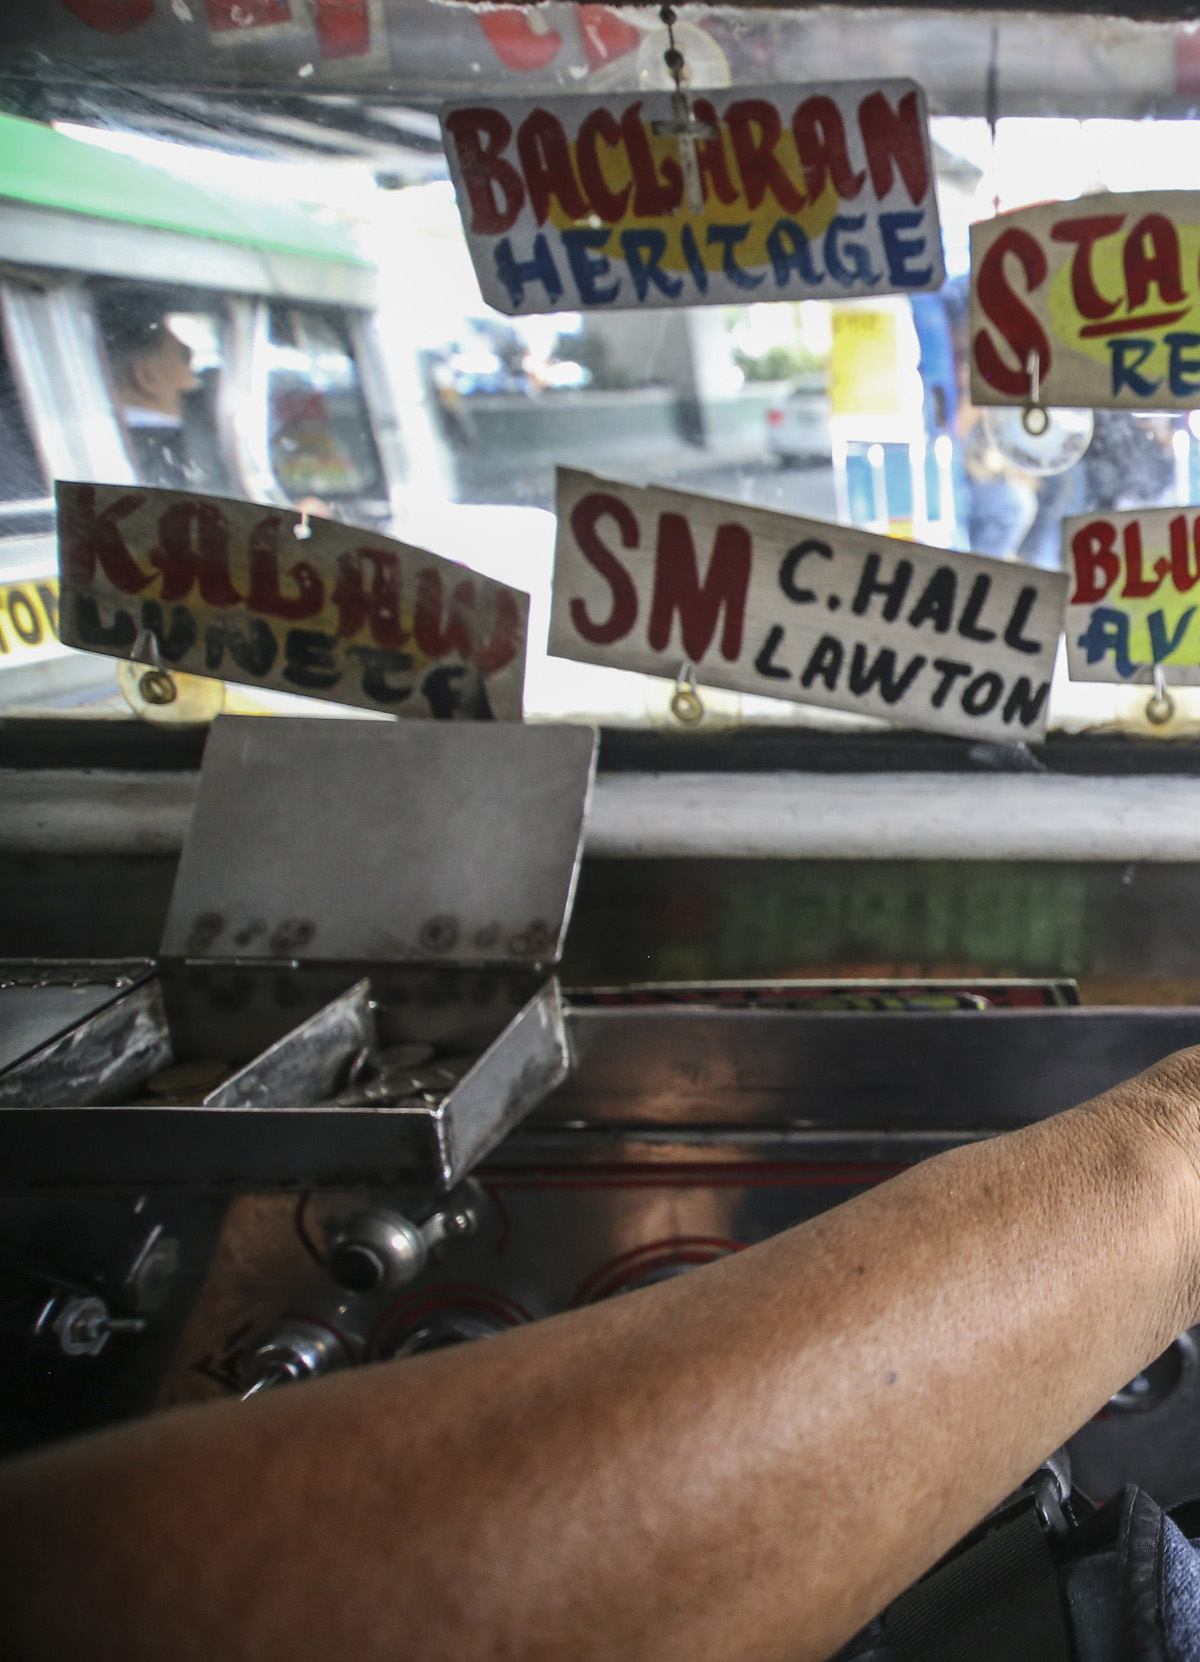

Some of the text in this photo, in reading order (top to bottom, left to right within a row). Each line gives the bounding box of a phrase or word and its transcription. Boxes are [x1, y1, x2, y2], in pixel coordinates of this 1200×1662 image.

[446, 90, 930, 235] BACLARAN
[494, 211, 935, 307] HERITAGE
[64, 484, 521, 673] KALAW
[569, 493, 752, 662] SM
[755, 625, 1052, 726] LAWTON
